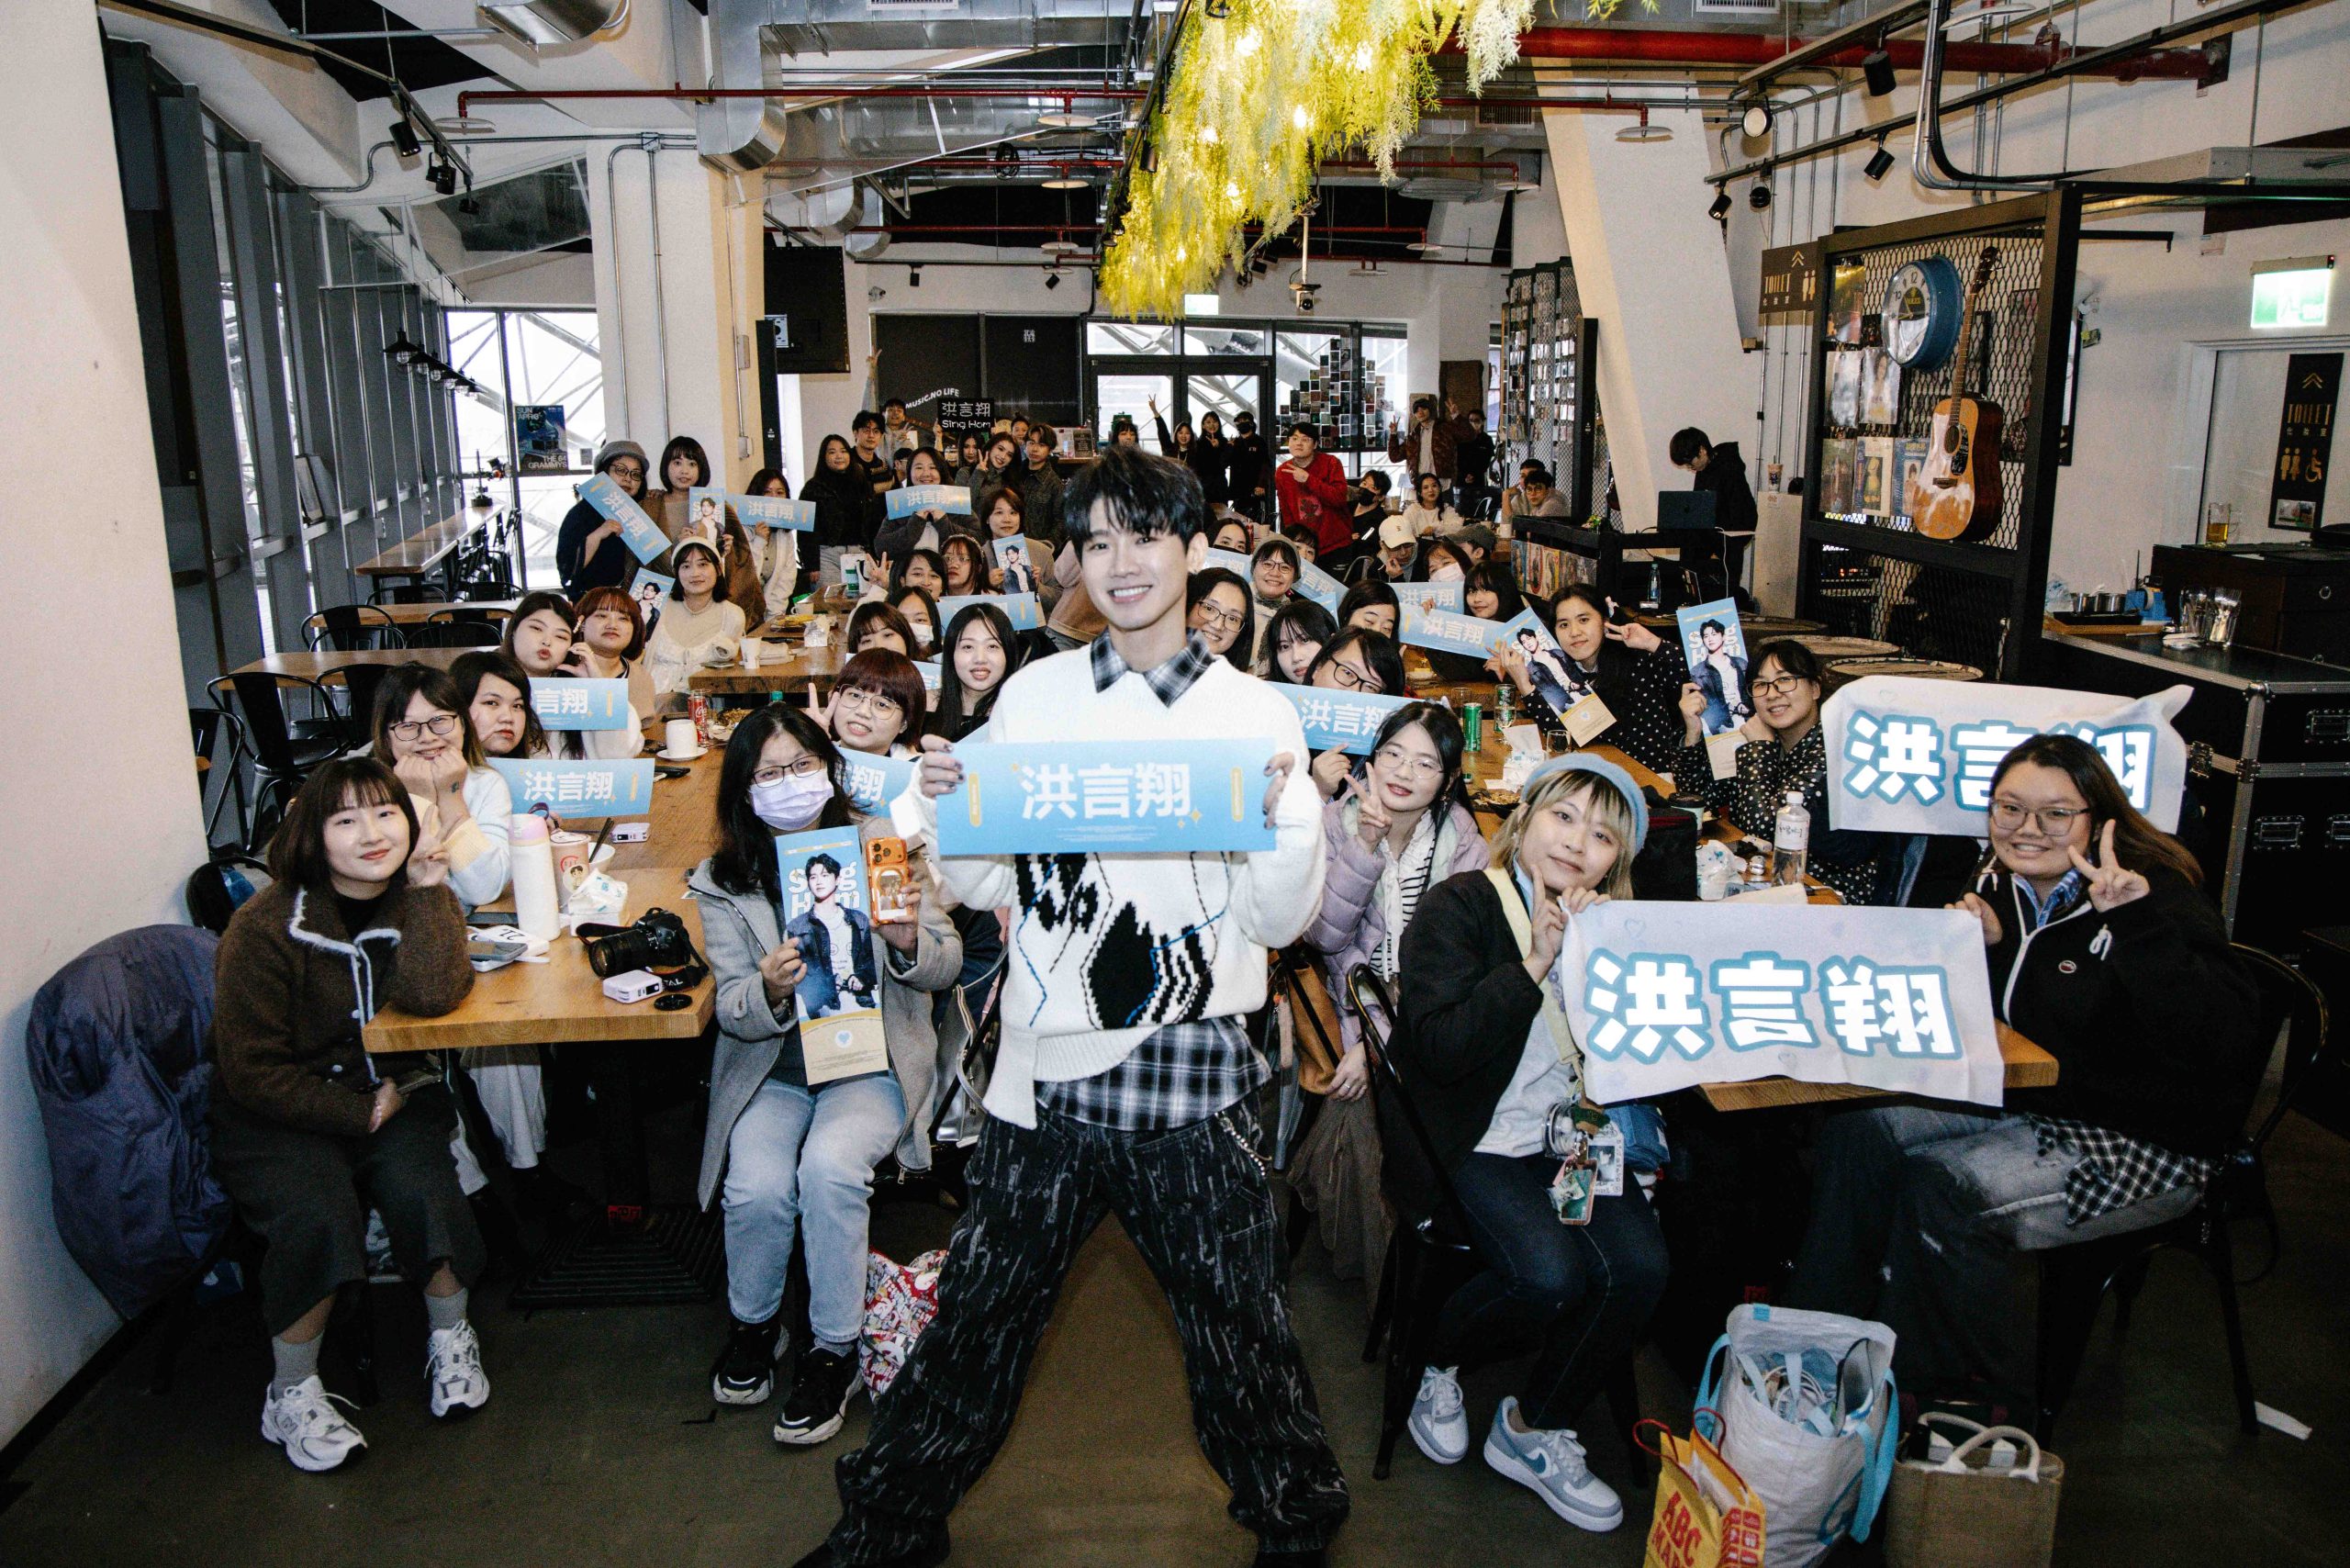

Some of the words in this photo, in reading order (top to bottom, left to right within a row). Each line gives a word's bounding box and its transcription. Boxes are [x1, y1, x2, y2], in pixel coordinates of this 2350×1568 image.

[1764, 273, 1792, 295] TOILET
[943, 387, 960, 398] LIFE
[941, 401, 991, 418] 洪言翔
[2287, 403, 2333, 426] TOILET
[942, 420, 967, 431] Sing
[528, 461, 567, 469] GRAMMYS
[543, 454, 556, 463] THE
[601, 491, 650, 540] 洪言翔
[747, 500, 795, 521] 洪言翔
[1401, 588, 1456, 607] 洪言翔
[1423, 614, 1486, 644] 洪言翔
[532, 687, 588, 715] 言翔
[523, 770, 614, 801] 洪言翔
[1021, 762, 1192, 820] 洪言翔
[1584, 946, 1963, 1065] 洪言翔
[1662, 1491, 1702, 1568] ABC
